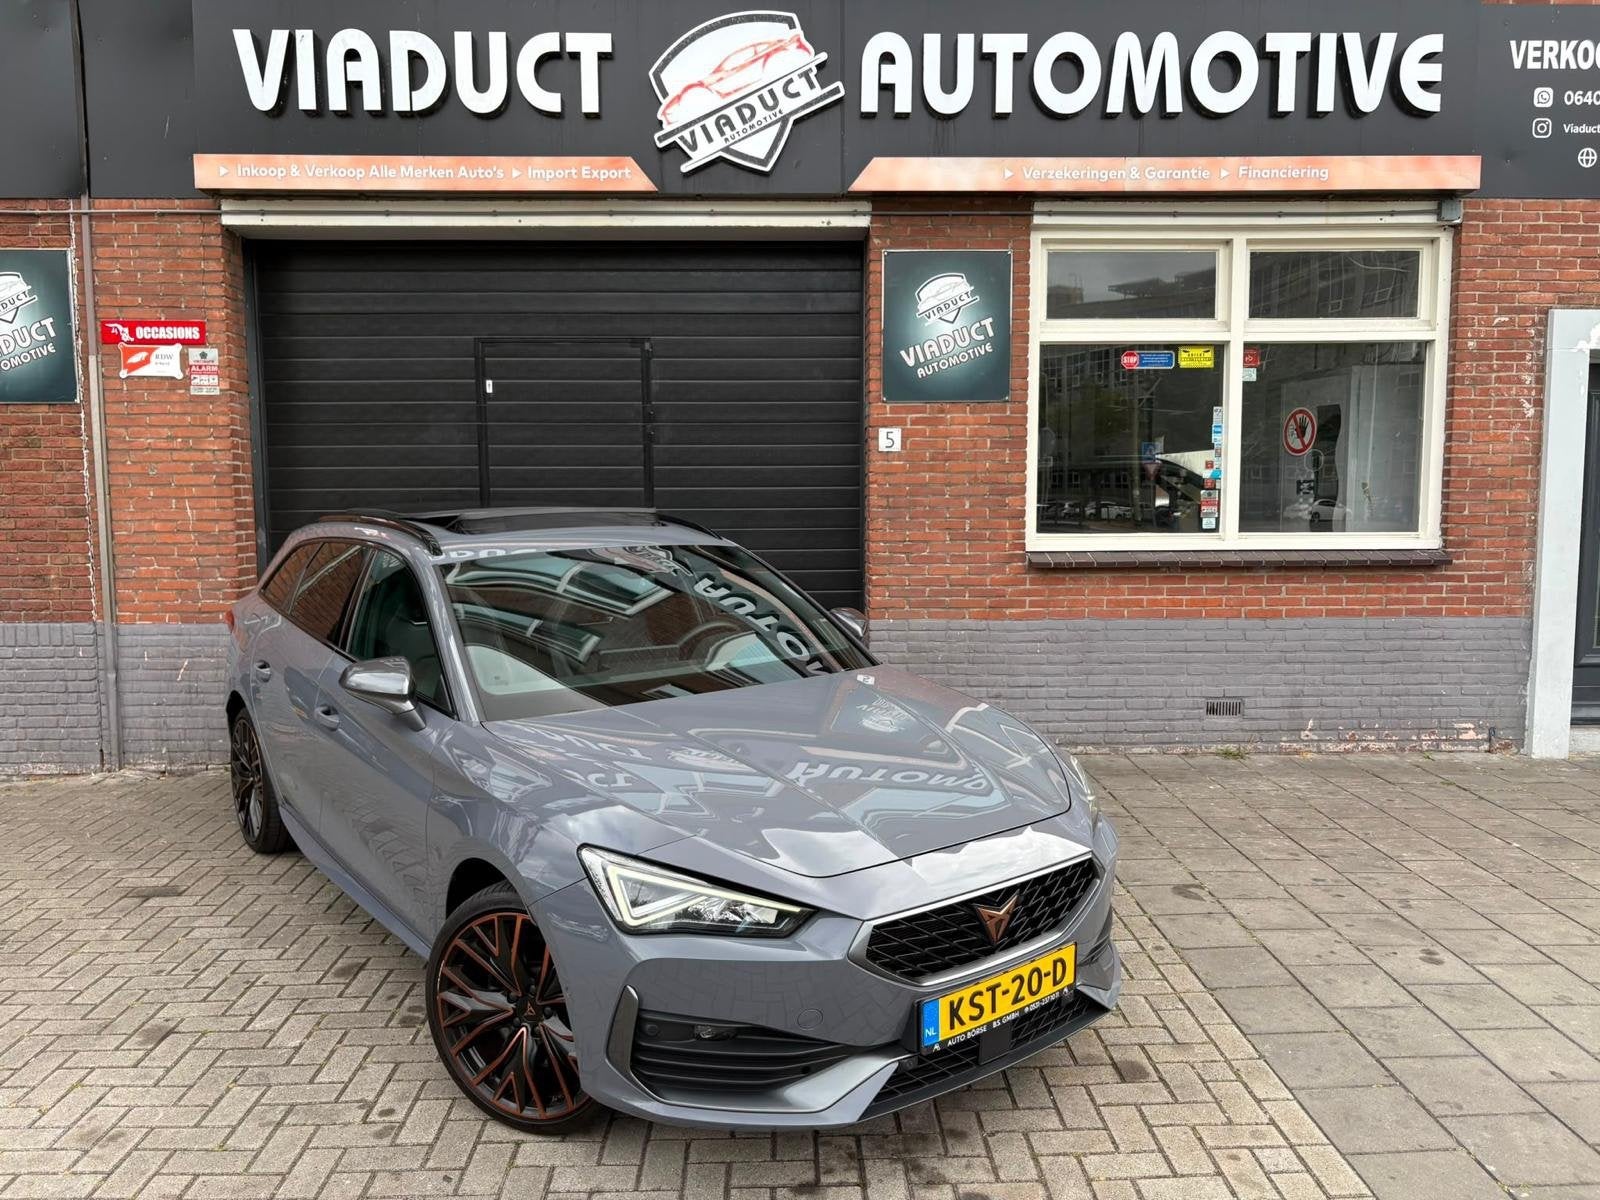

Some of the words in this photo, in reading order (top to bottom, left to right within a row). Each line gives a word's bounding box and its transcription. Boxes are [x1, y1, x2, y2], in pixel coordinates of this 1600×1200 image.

[1509, 39, 1600, 70] VERKO
[232, 28, 612, 113] VIADUCT
[860, 30, 1444, 114] AUTOMOTIVE
[677, 67, 817, 153] VIADUCT
[723, 108, 784, 144] AUTOMOTIVE
[1563, 123, 1600, 134] Viaduct
[237, 164, 287, 182] Inkoop
[290, 165, 301, 177] &
[303, 165, 365, 181] Verkoop
[368, 165, 397, 178] Alle
[400, 166, 454, 179] Merken
[457, 166, 504, 179] Auto's
[527, 166, 577, 182] Import
[581, 166, 632, 182] Export
[1022, 166, 1127, 182] Verzekeringen
[1129, 166, 1141, 179] &
[1144, 166, 1211, 179] Garantie
[1238, 166, 1329, 181] Financiering
[925, 291, 971, 320] VIADUCT
[135, 326, 201, 340] OCCASIONS
[899, 317, 995, 367] VIADUCT
[0, 342, 56, 371] OMOTIVE
[916, 342, 994, 379] AUTOMOTIVE
[1123, 355, 1138, 364] STOP
[191, 365, 219, 373] ALARM
[884, 430, 896, 449] 5
[949, 956, 1067, 1031] KST-20-D
[925, 1026, 938, 1039] NL
[947, 1033, 966, 1047] AUTO
